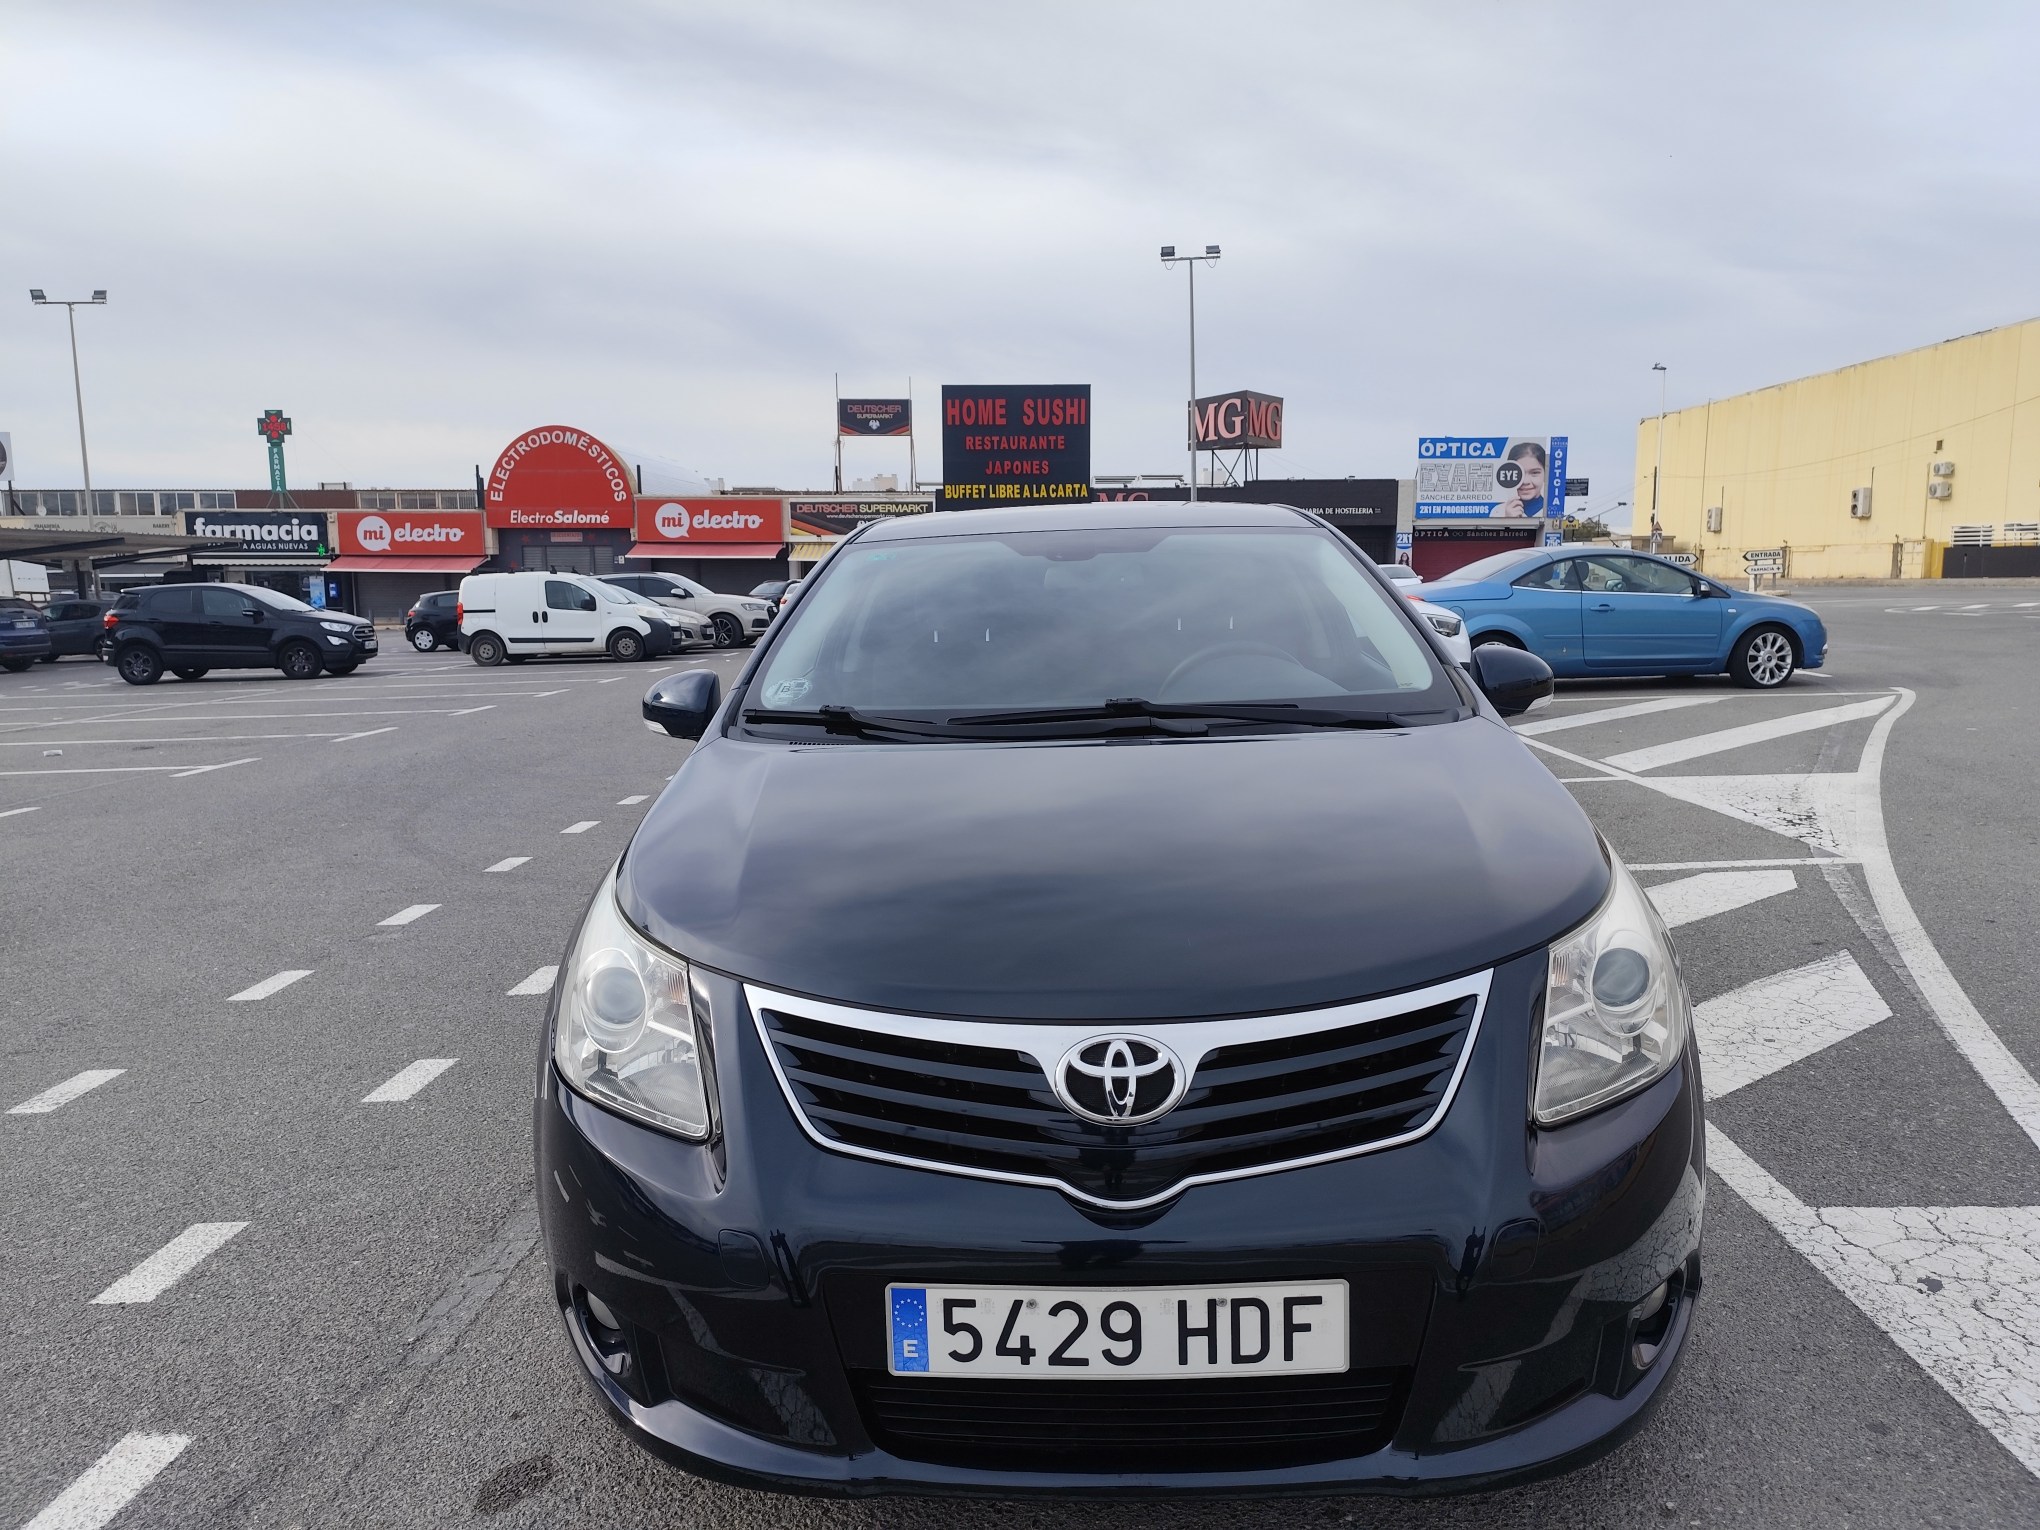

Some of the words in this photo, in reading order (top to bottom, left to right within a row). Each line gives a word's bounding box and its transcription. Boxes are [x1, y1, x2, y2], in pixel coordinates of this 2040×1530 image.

[847, 404, 902, 413] DEUTSCHER
[946, 398, 1007, 426] HOME
[1022, 398, 1086, 426] SUSHI
[1188, 398, 1245, 442] MG
[1247, 398, 1282, 441] MG
[965, 436, 1065, 450] RESTAURANTE
[1420, 440, 1496, 457] ÓPTICA
[273, 447, 281, 491] FARMACIA
[490, 430, 627, 502] ELECTRODOMÉSTICOS
[985, 460, 1049, 475] JAPONES
[1500, 470, 1519, 481] EYE
[945, 484, 986, 499] BUFFET
[989, 484, 1021, 498] LIBRE
[1023, 485, 1031, 498] A
[1033, 484, 1048, 498] LA
[1049, 483, 1088, 498] CARTA
[1420, 493, 1455, 501] SÁNCHEZ
[796, 503, 858, 513] DEUTSCHER
[859, 503, 928, 513] SUPERMARKT
[1325, 507, 1334, 515] DE
[1420, 505, 1432, 514] 2X1
[1433, 505, 1441, 514] EN
[1442, 505, 1489, 514] PROGRESIVOS
[510, 510, 610, 524] ElectroSalomé
[660, 513, 684, 528] mi
[692, 509, 764, 529] electro
[194, 517, 319, 541] farmacia
[363, 525, 386, 541] mi
[393, 522, 465, 542] electro
[1396, 533, 1412, 544] 2X1
[943, 1298, 1142, 1366] 5429
[1177, 1296, 1323, 1365] HDF
[903, 1339, 919, 1358] E
